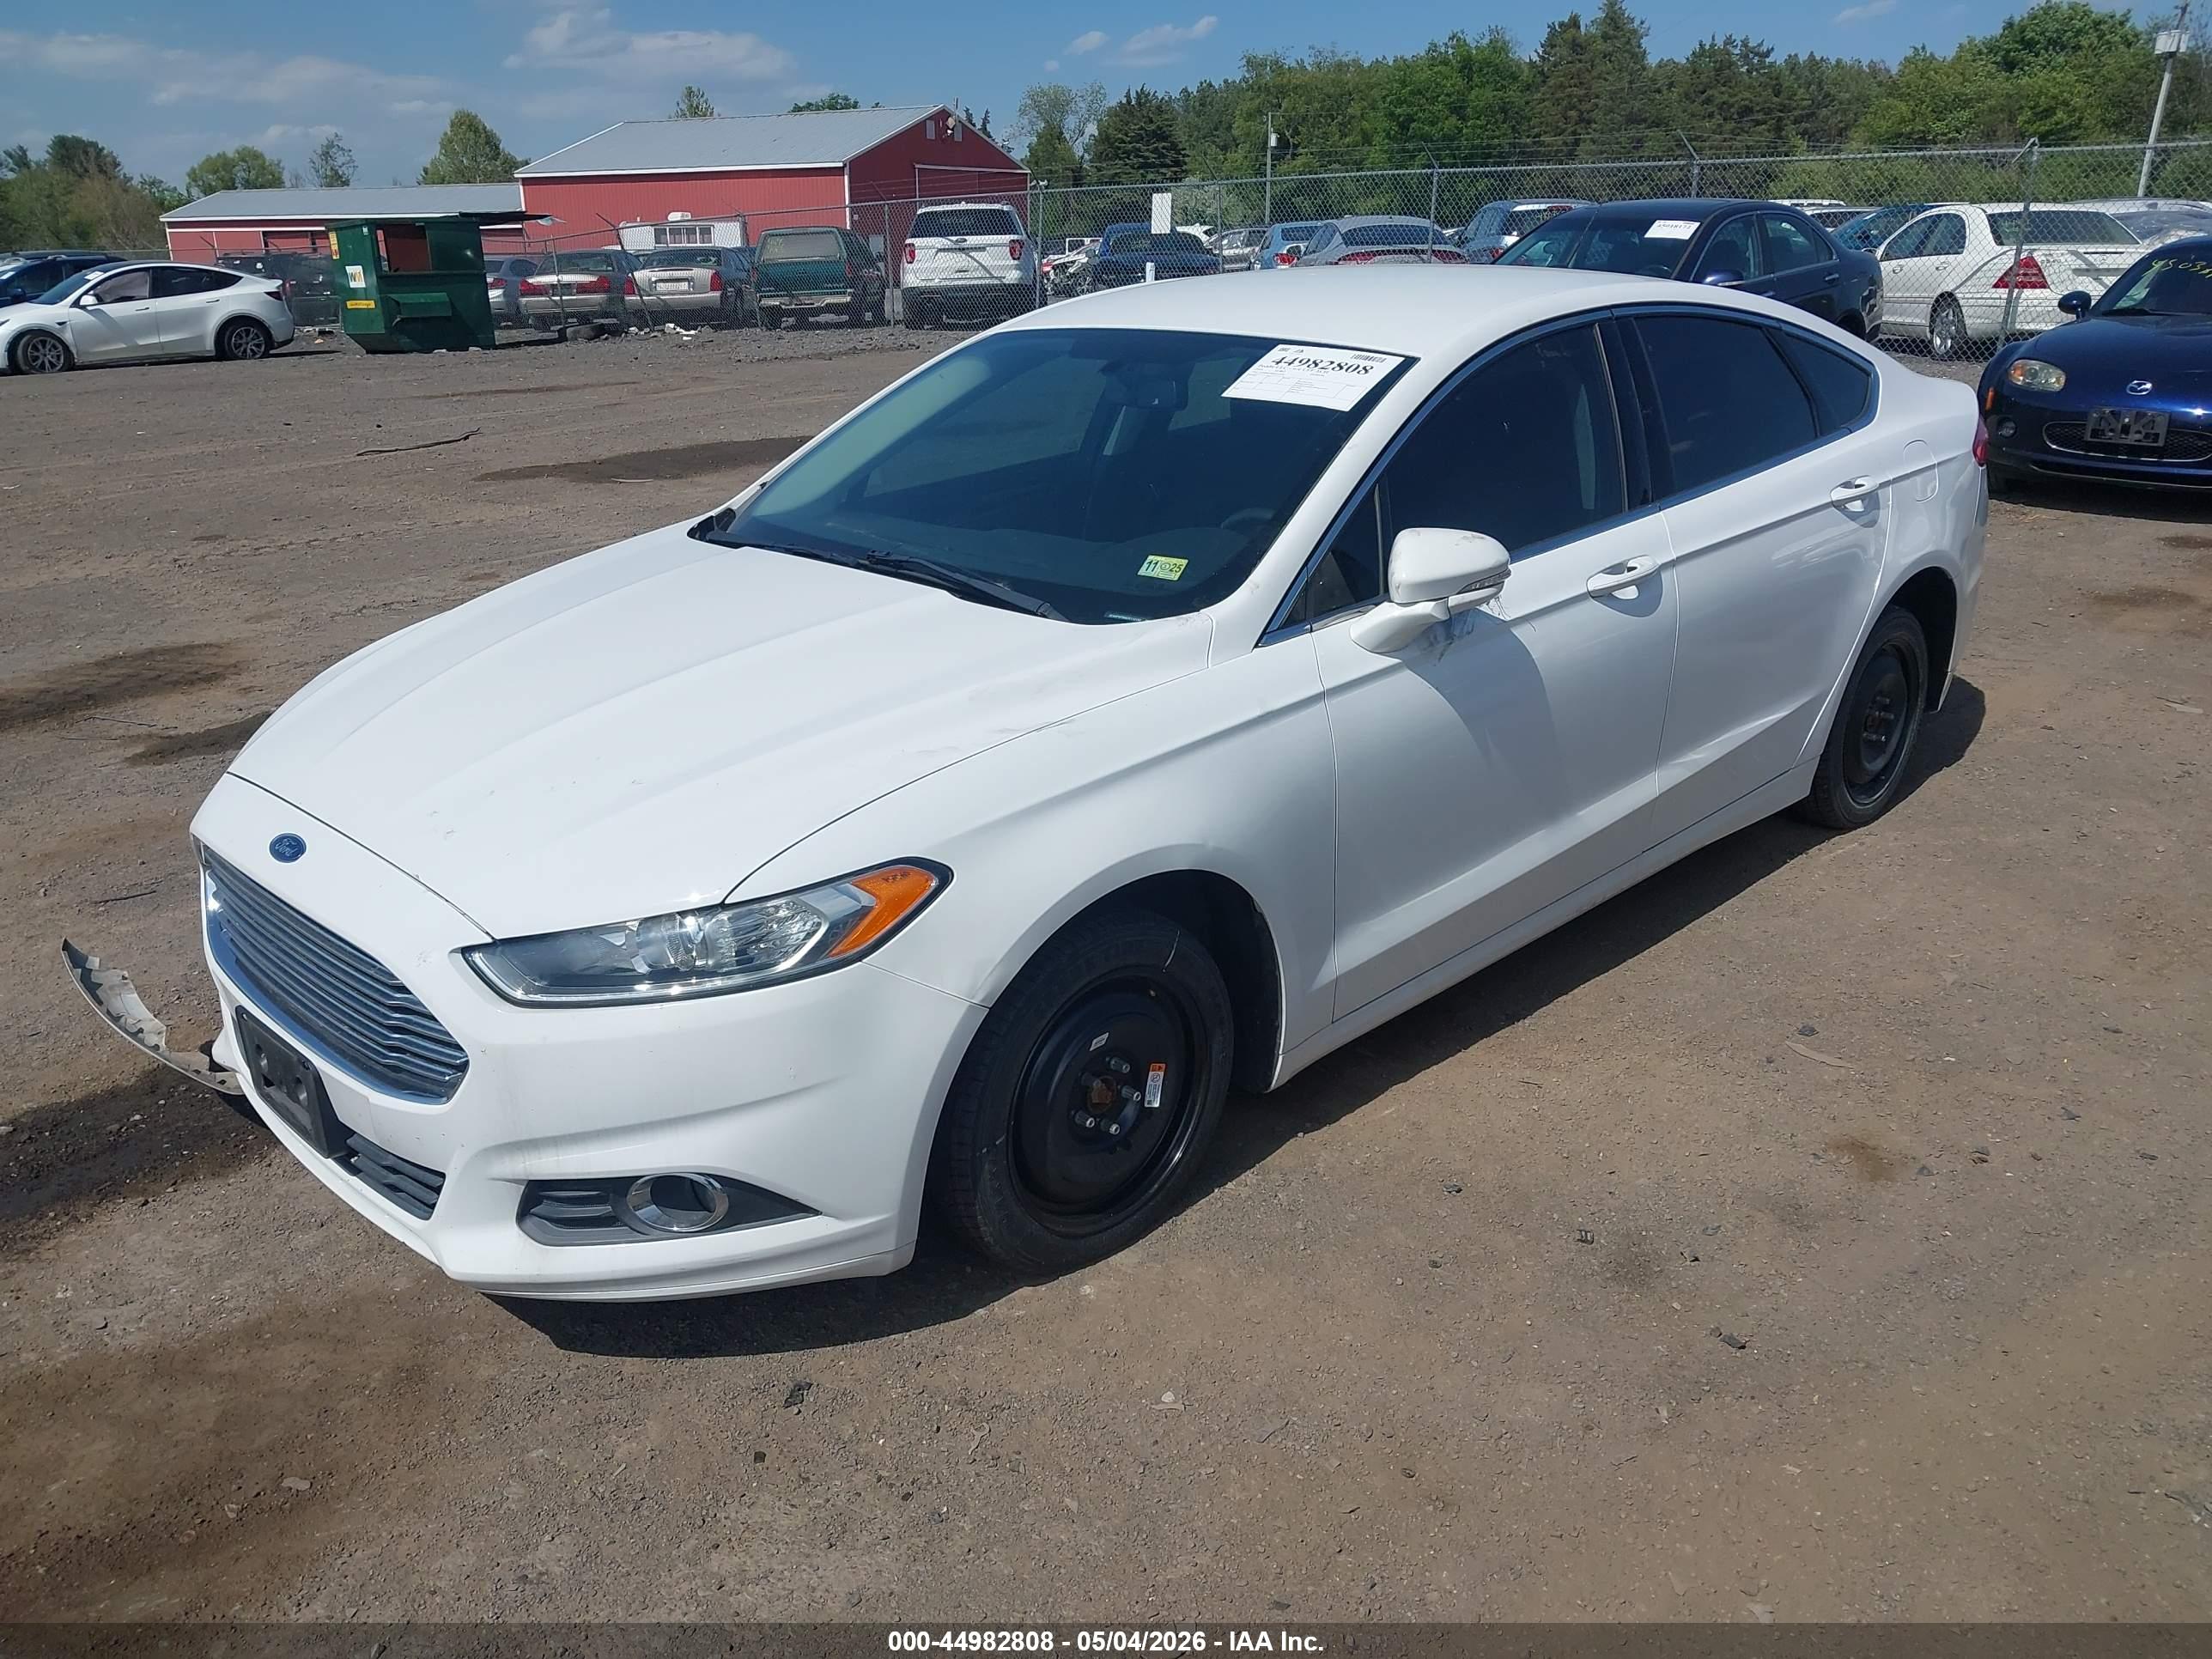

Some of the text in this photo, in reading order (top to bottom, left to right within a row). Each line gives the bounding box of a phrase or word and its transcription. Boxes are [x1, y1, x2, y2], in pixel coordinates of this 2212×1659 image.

[1271, 356, 1375, 375] 44982808
[1144, 559, 1184, 574] 11 25
